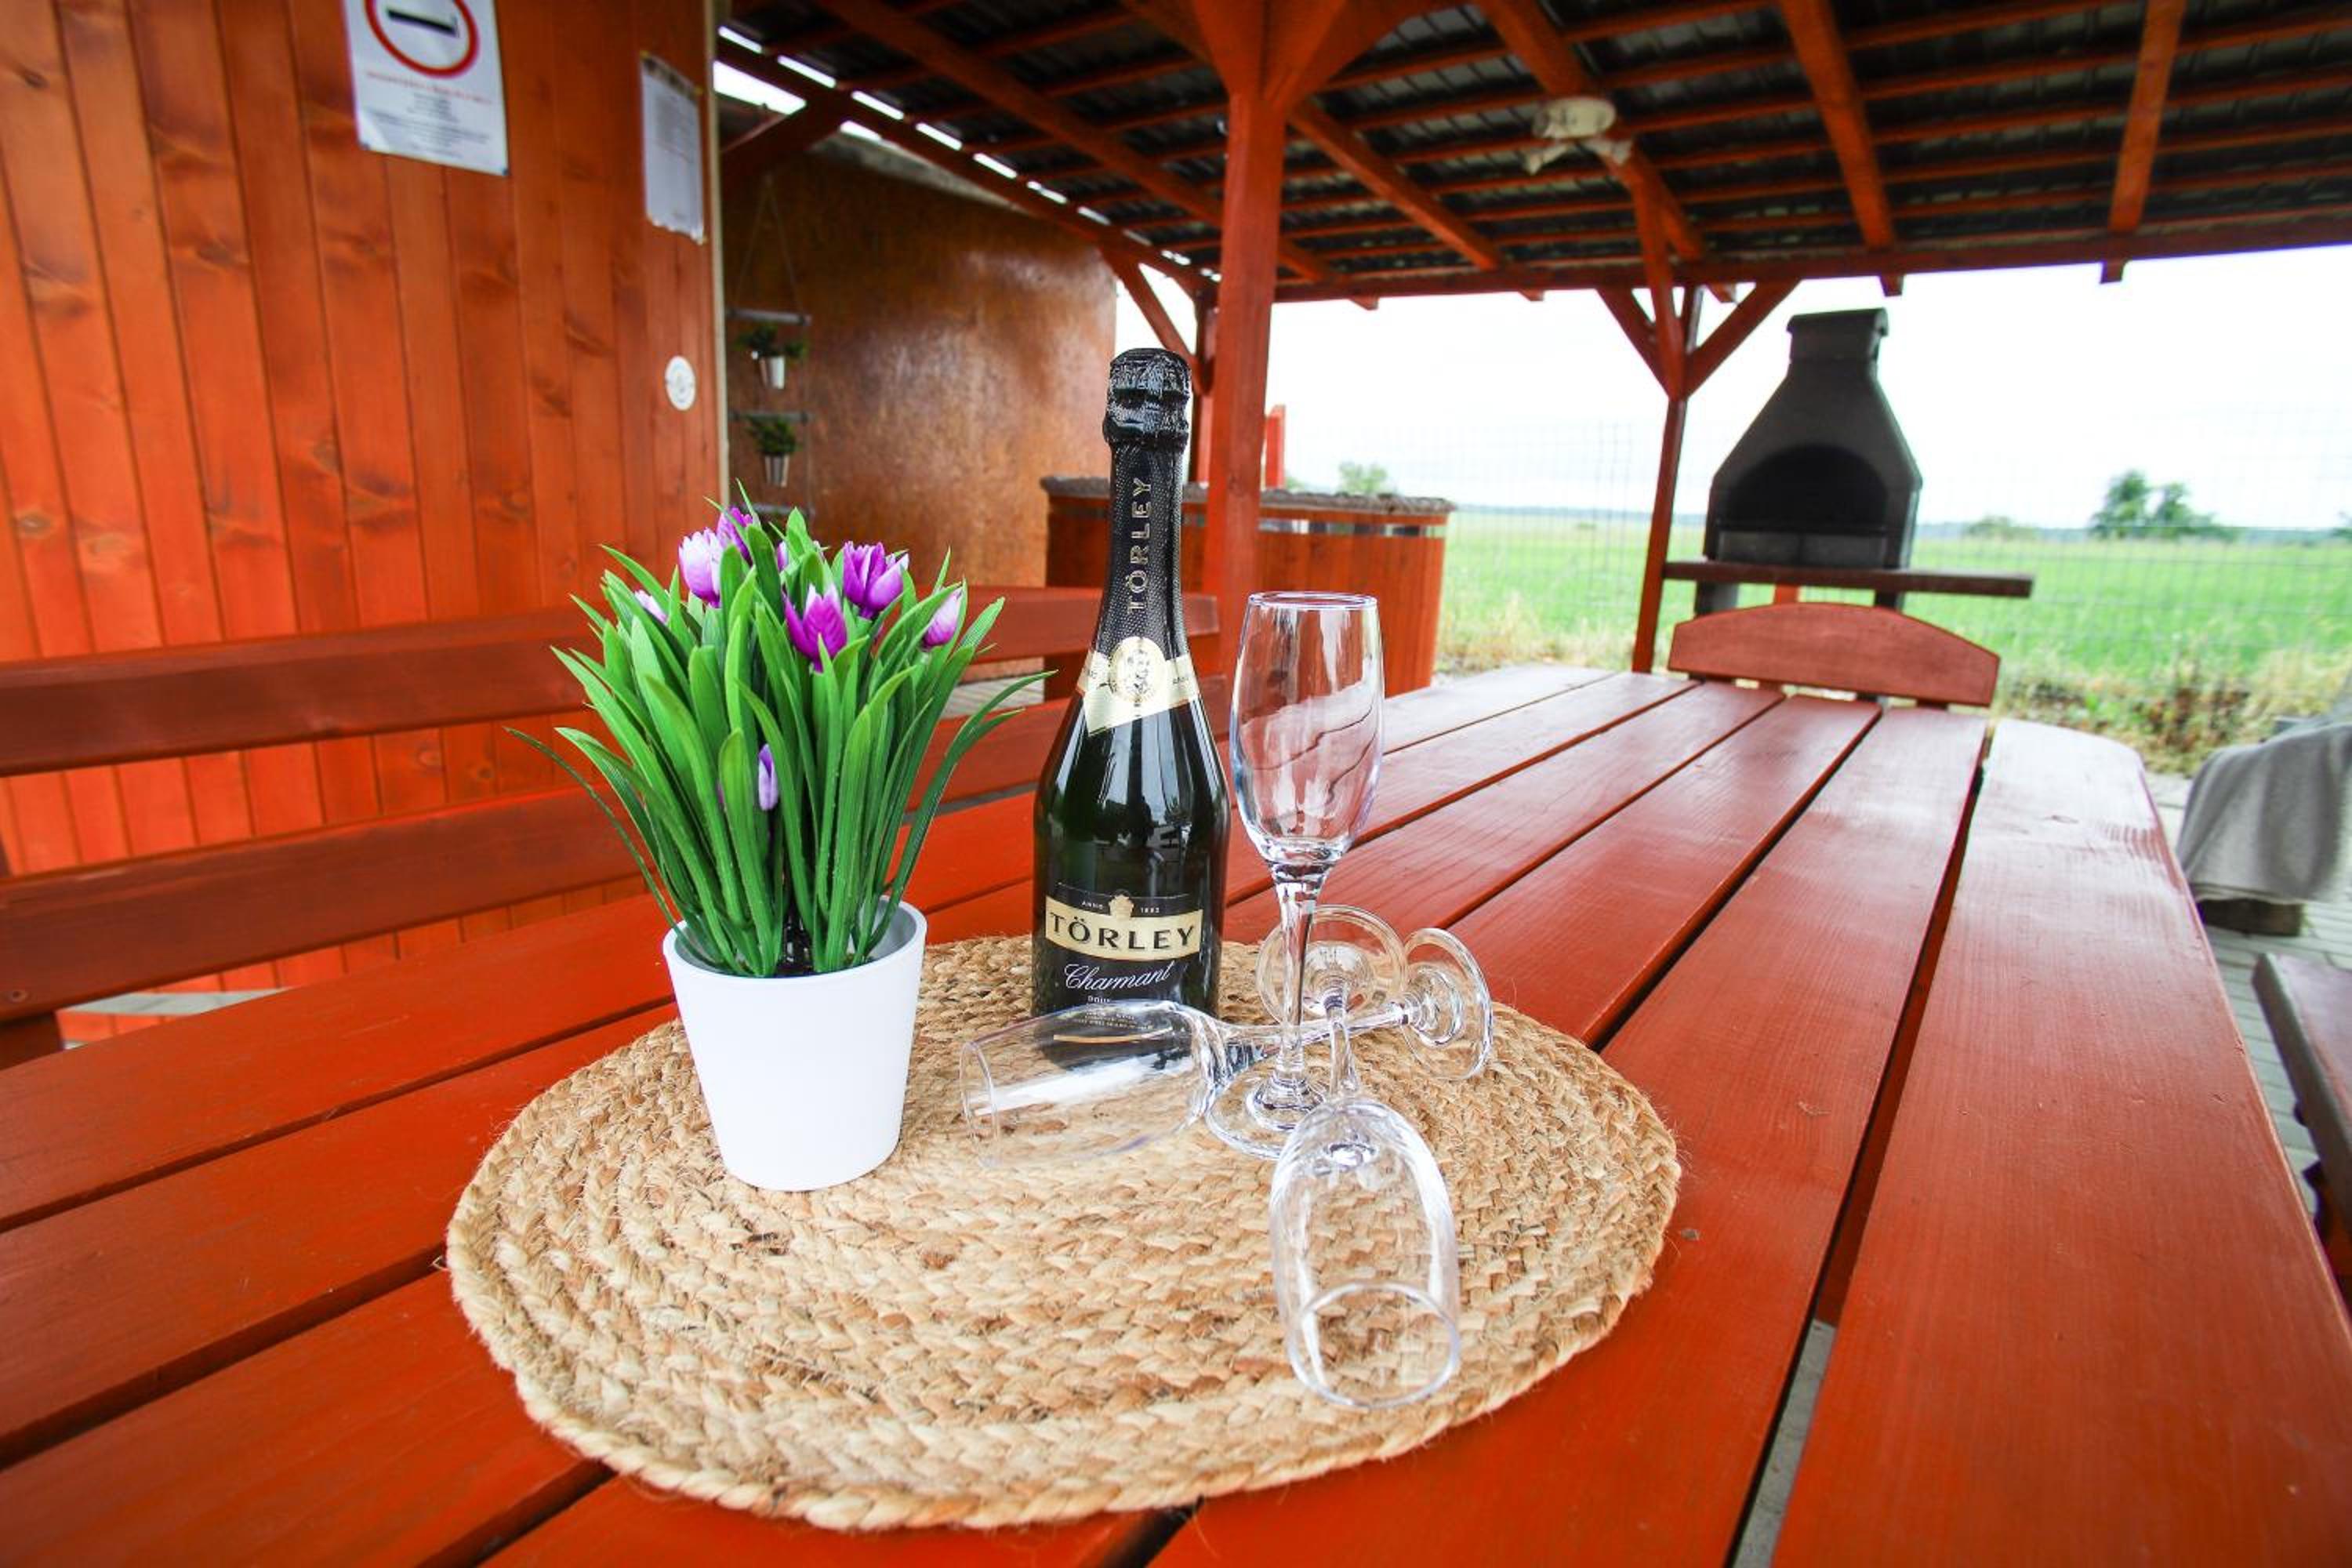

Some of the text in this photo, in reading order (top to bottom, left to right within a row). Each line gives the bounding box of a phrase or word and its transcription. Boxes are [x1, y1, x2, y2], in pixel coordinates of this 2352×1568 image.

[1126, 477, 1152, 614] TÖRLEY
[1050, 912, 1195, 950] TÖRLEY
[1063, 959, 1176, 990] Charmant
